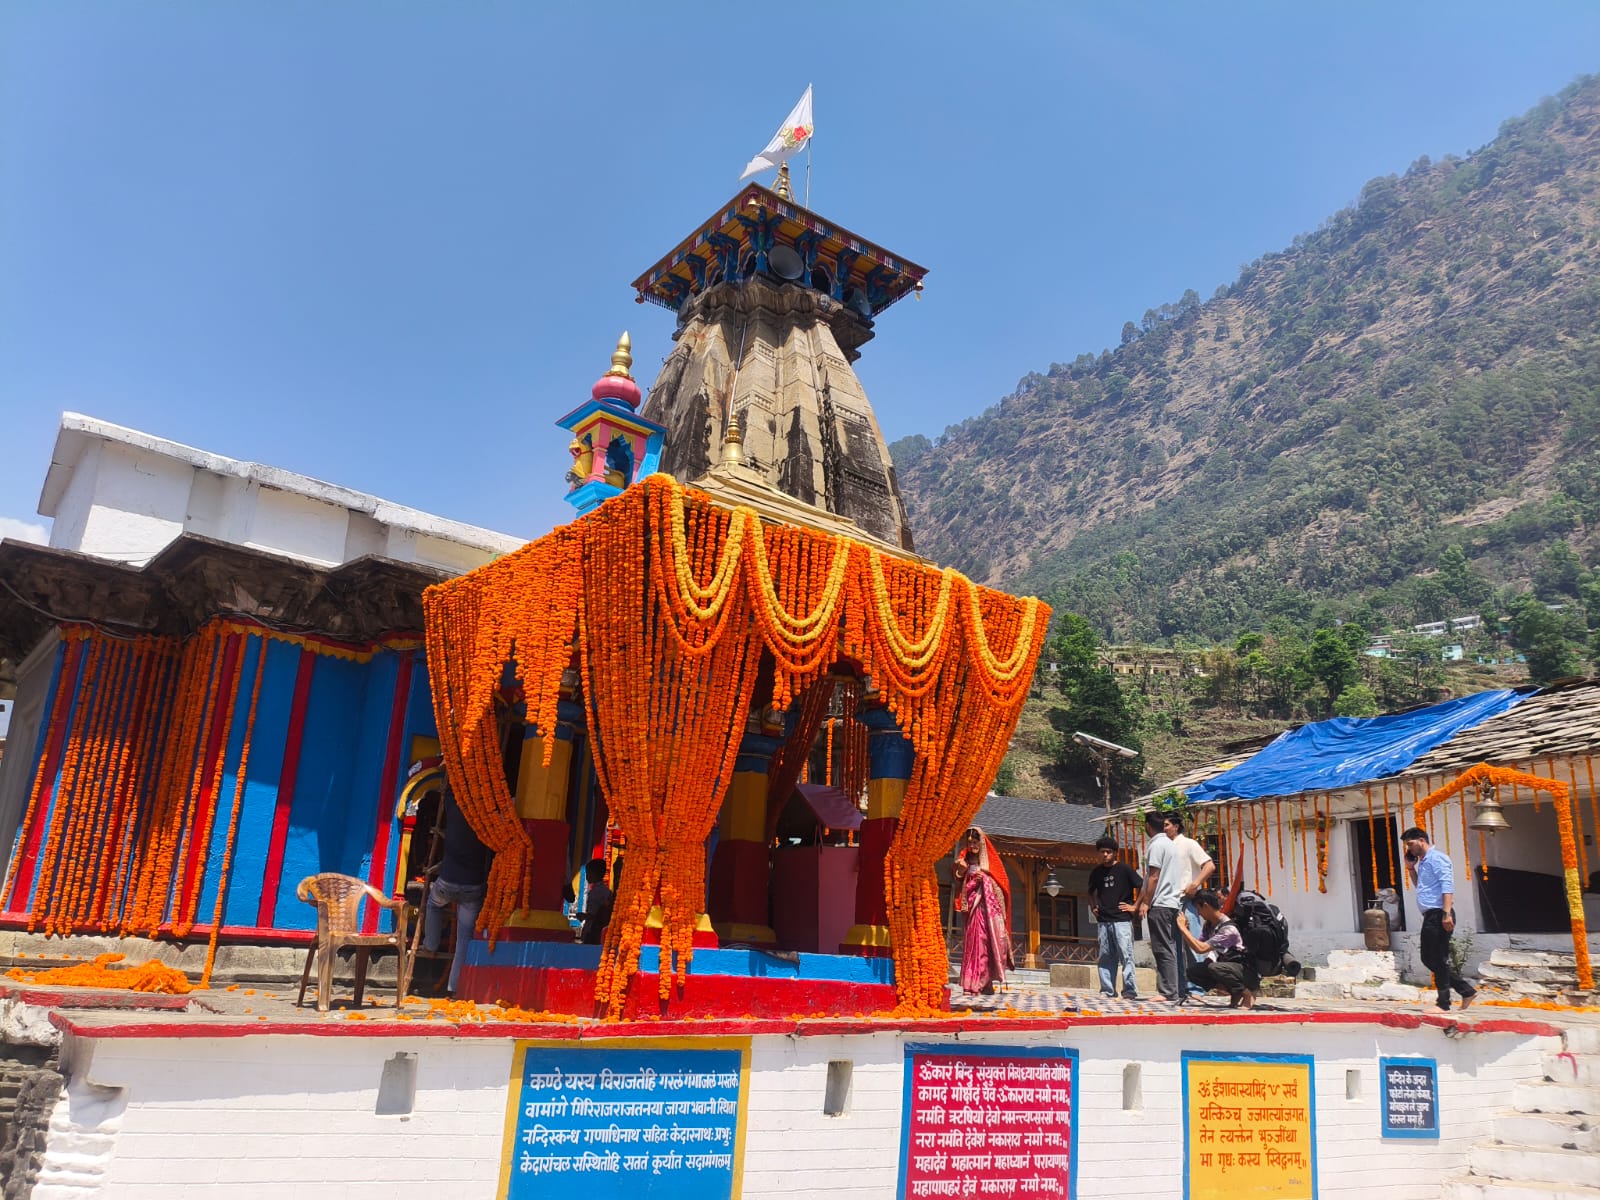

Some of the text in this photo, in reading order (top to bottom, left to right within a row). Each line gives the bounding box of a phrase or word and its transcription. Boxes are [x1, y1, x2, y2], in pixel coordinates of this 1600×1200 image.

[530, 1067, 739, 1092] कण्ठे यस्य विराजतेहि गरलं गंगाजलं मस्तके
[976, 1061, 1006, 1086] संयुक्तं
[918, 1082, 948, 1105] कामदं
[951, 1082, 980, 1105] मोक्षदं
[982, 1081, 997, 1102] चैव
[1035, 1084, 1052, 1103] नमो
[1212, 1077, 1266, 1101] ईशावास्यमिदं
[525, 1095, 568, 1118] वामांगे
[571, 1097, 664, 1118] गिरिराजराजतनया
[665, 1101, 690, 1116] जाया
[691, 1097, 716, 1115] भवानी
[916, 1105, 946, 1125] नमंति
[985, 1104, 1001, 1127] देवो
[584, 1123, 641, 1144] गणाधिनाथ
[642, 1124, 670, 1143] सहितः
[670, 1122, 714, 1145] केदारनाथः
[714, 1127, 732, 1147] प्रभुः
[915, 1132, 936, 1149] नरा
[938, 1129, 964, 1148] नमंति
[965, 1127, 986, 1150] देवेशं
[988, 1132, 1022, 1150] नकाराय
[1024, 1127, 1044, 1147] नमो
[1199, 1124, 1215, 1143] तेन
[1220, 1123, 1253, 1143] त्यक्तेन
[520, 1150, 572, 1176] केदारांचल
[622, 1150, 649, 1170] सततं
[685, 1149, 732, 1171] सदामंगलम्
[914, 1151, 948, 1174] महादेवं
[951, 1151, 992, 1172] महात्मानं
[1200, 1153, 1213, 1167] मा
[1218, 1153, 1235, 1174] गृधः
[1237, 1153, 1261, 1167] कस्य
[912, 1175, 961, 1198] महापापहरं
[962, 1174, 978, 1197] देवं
[980, 1178, 1018, 1199] मकाराय
[1020, 1172, 1040, 1192] नमो
